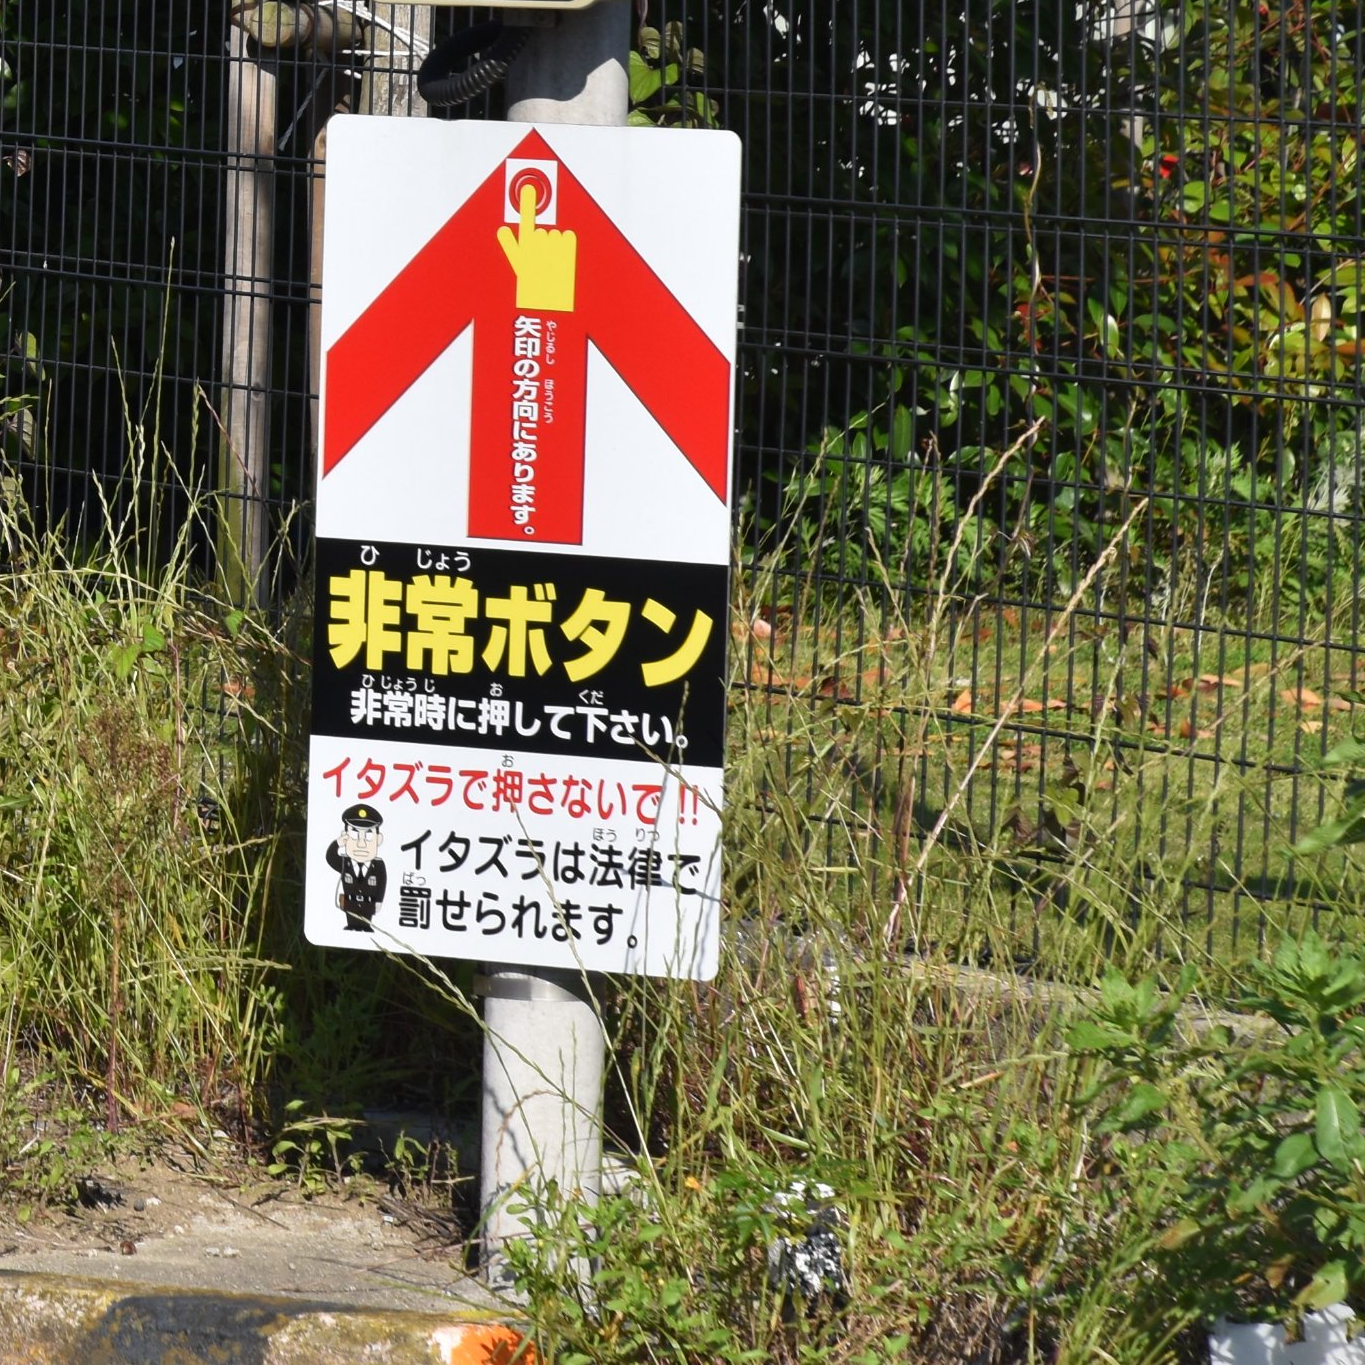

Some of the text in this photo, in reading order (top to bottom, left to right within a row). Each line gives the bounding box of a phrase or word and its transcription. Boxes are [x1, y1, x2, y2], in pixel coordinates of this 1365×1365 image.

[545, 320, 557, 365] やじるし
[510, 315, 542, 536] 矢印の方向にあります。
[359, 545, 472, 572] ひ じょう
[327, 568, 714, 688] 非常ボタン
[350, 688, 689, 749] 非常時に押して下さい。
[400, 829, 701, 895] イタズラは法律で
[398, 886, 638, 950] 罰せられます。
